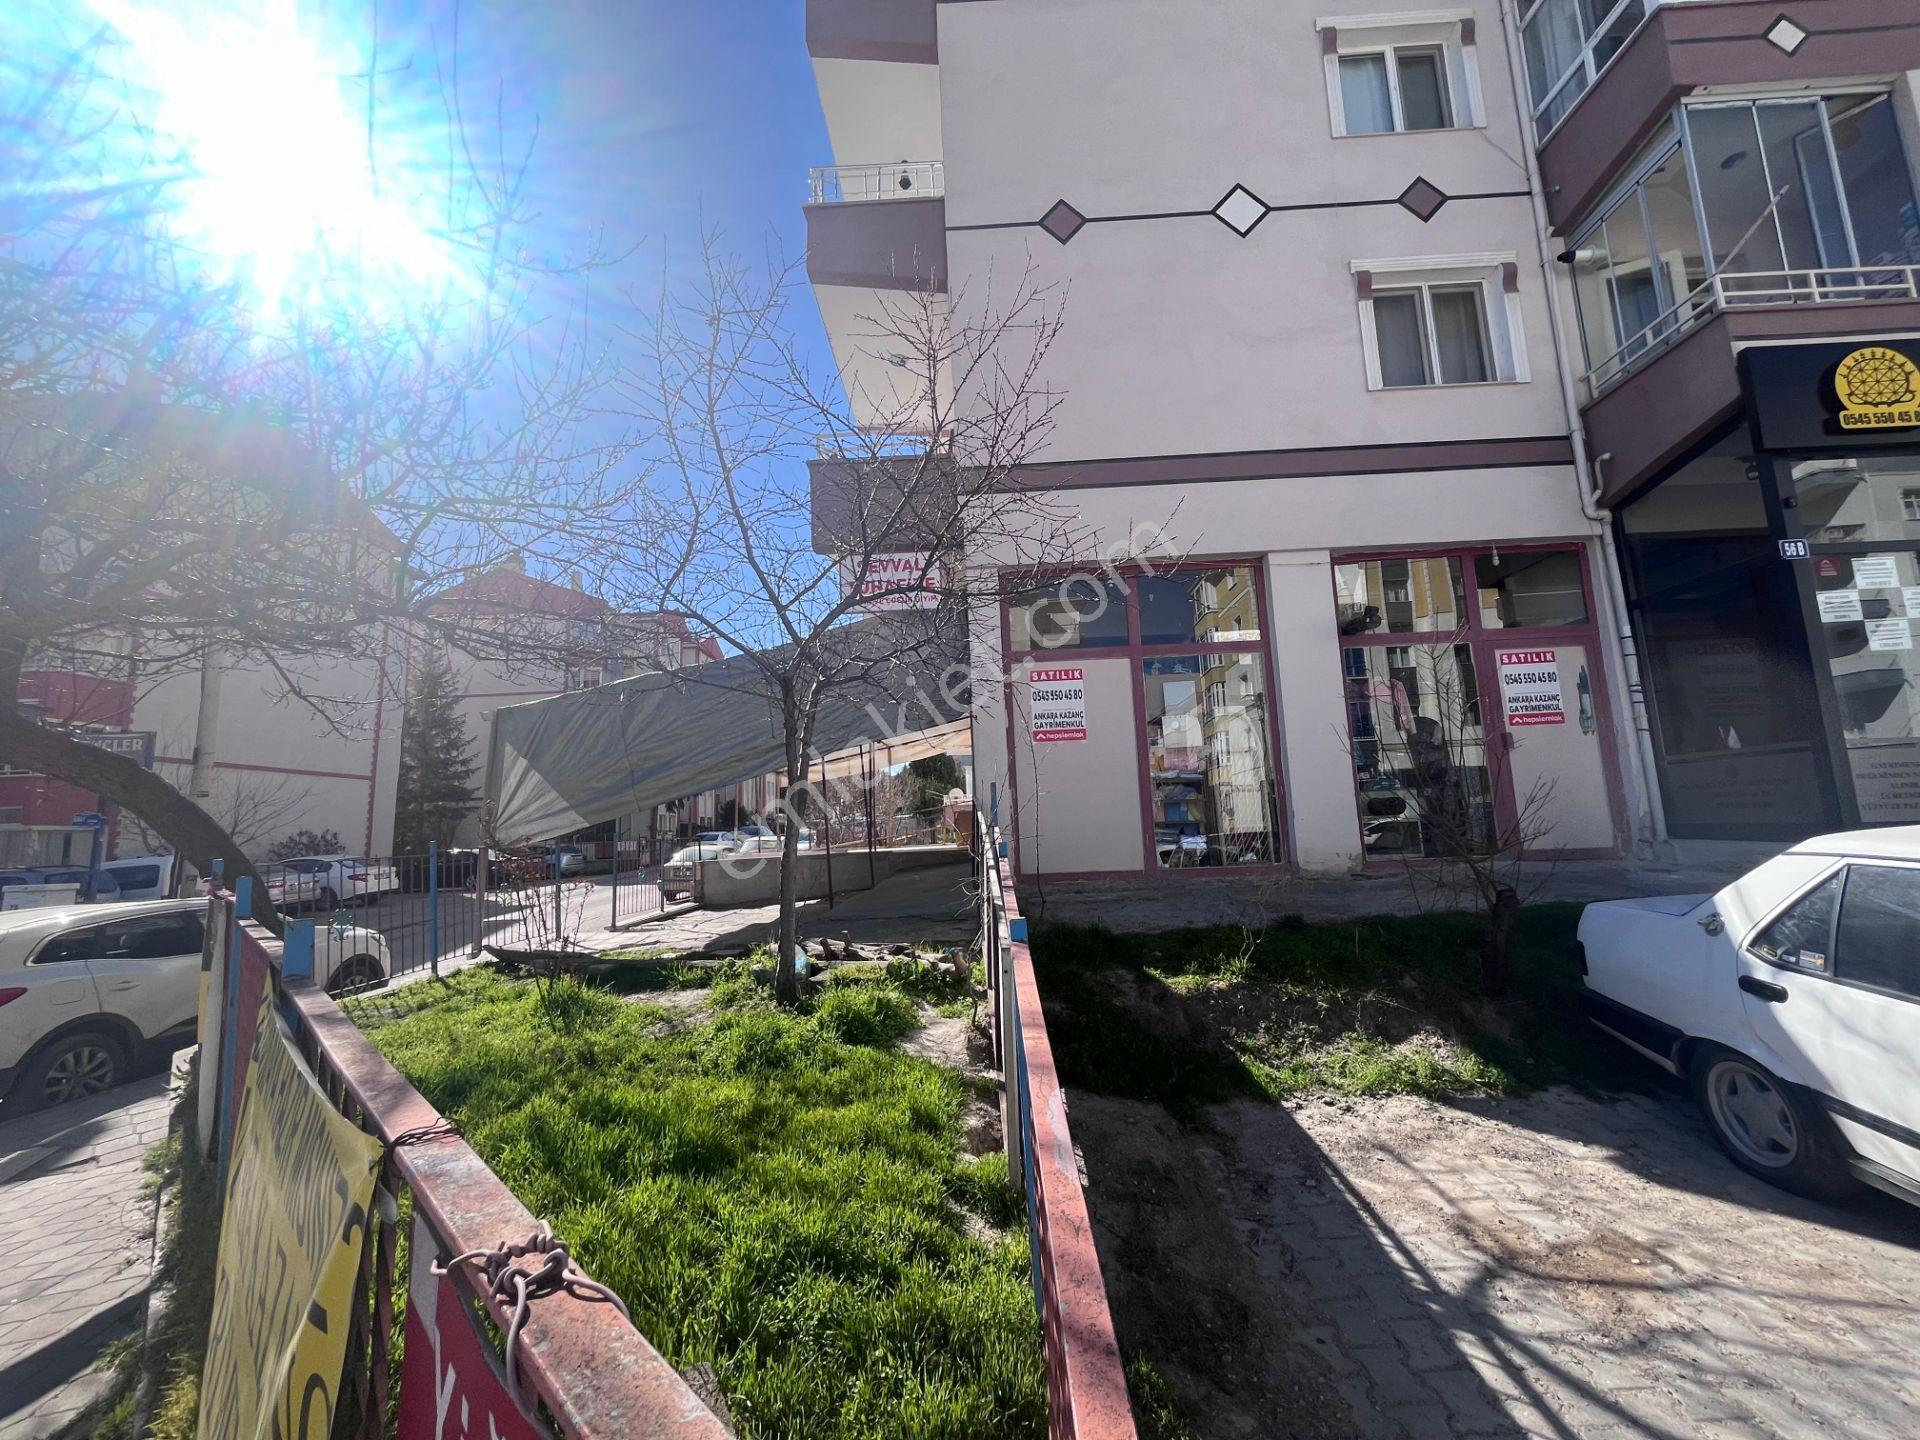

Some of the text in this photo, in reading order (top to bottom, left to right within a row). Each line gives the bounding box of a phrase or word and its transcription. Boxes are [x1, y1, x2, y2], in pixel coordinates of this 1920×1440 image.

[1843, 413, 1872, 426] 0545
[1873, 412, 1896, 425] 550
[1897, 411, 1913, 423] 45
[1502, 652, 1554, 663] SATILIK
[1032, 670, 1081, 680] SATILIK
[1504, 671, 1557, 685] 0545 550 45 80
[1032, 689, 1083, 702] 0545 550 45 80
[1508, 694, 1561, 704] ANKARA KAZANÇ
[1034, 711, 1084, 720] ANKARA KAZANÇ
